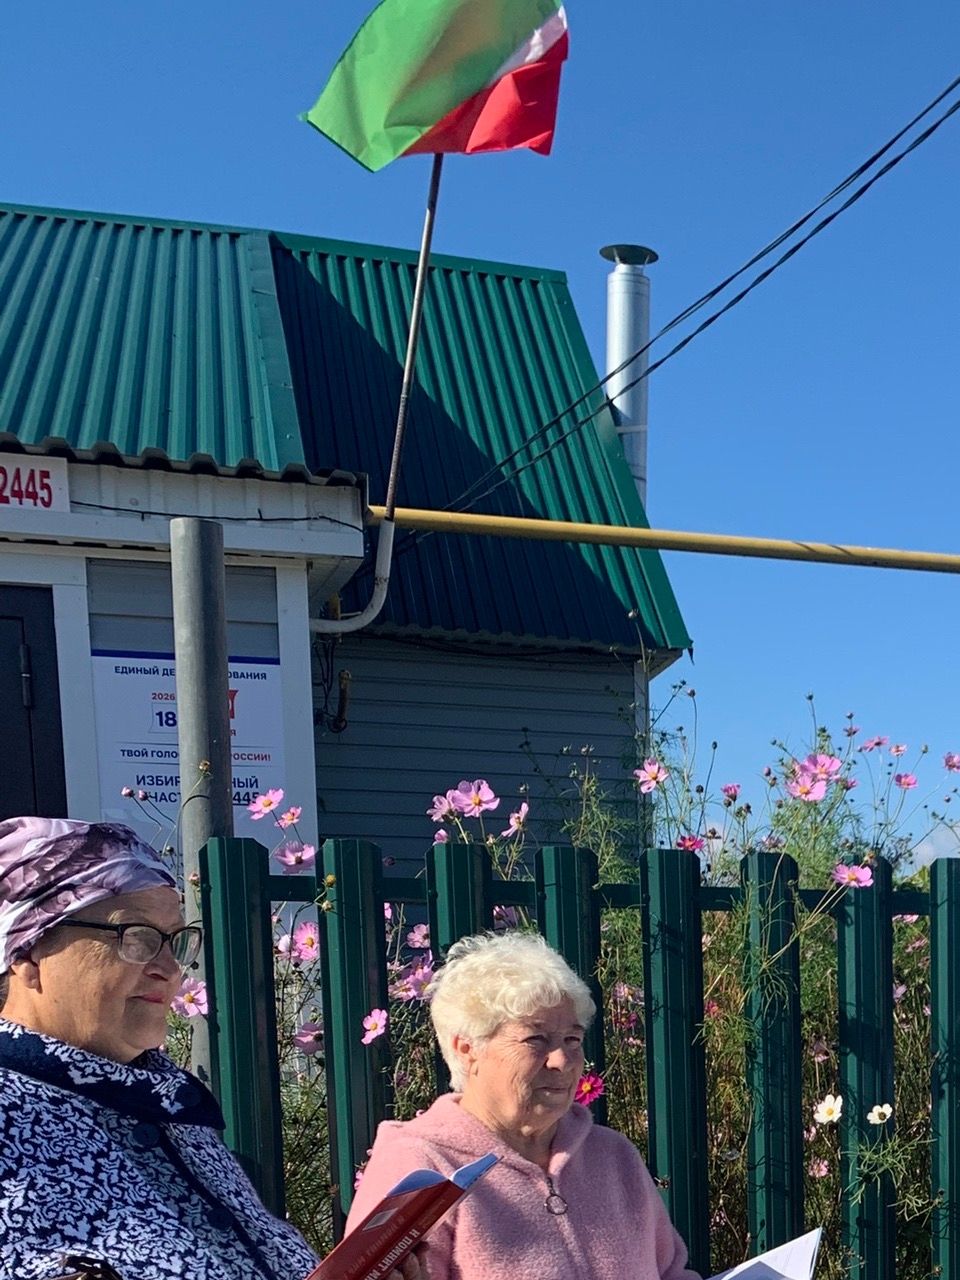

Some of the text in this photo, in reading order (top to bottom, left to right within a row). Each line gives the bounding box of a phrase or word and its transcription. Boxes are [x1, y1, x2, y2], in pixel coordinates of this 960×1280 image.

[0, 465, 53, 509] 2445
[114, 665, 267, 680] ЕДИНЫЙ ДЕ ОВАНИЯ
[151, 692, 176, 701] 2026
[151, 750, 179, 759] ГОЛО
[231, 752, 271, 762] ОССИИ!
[381, 1237, 413, 1272] ПОМНИТ
